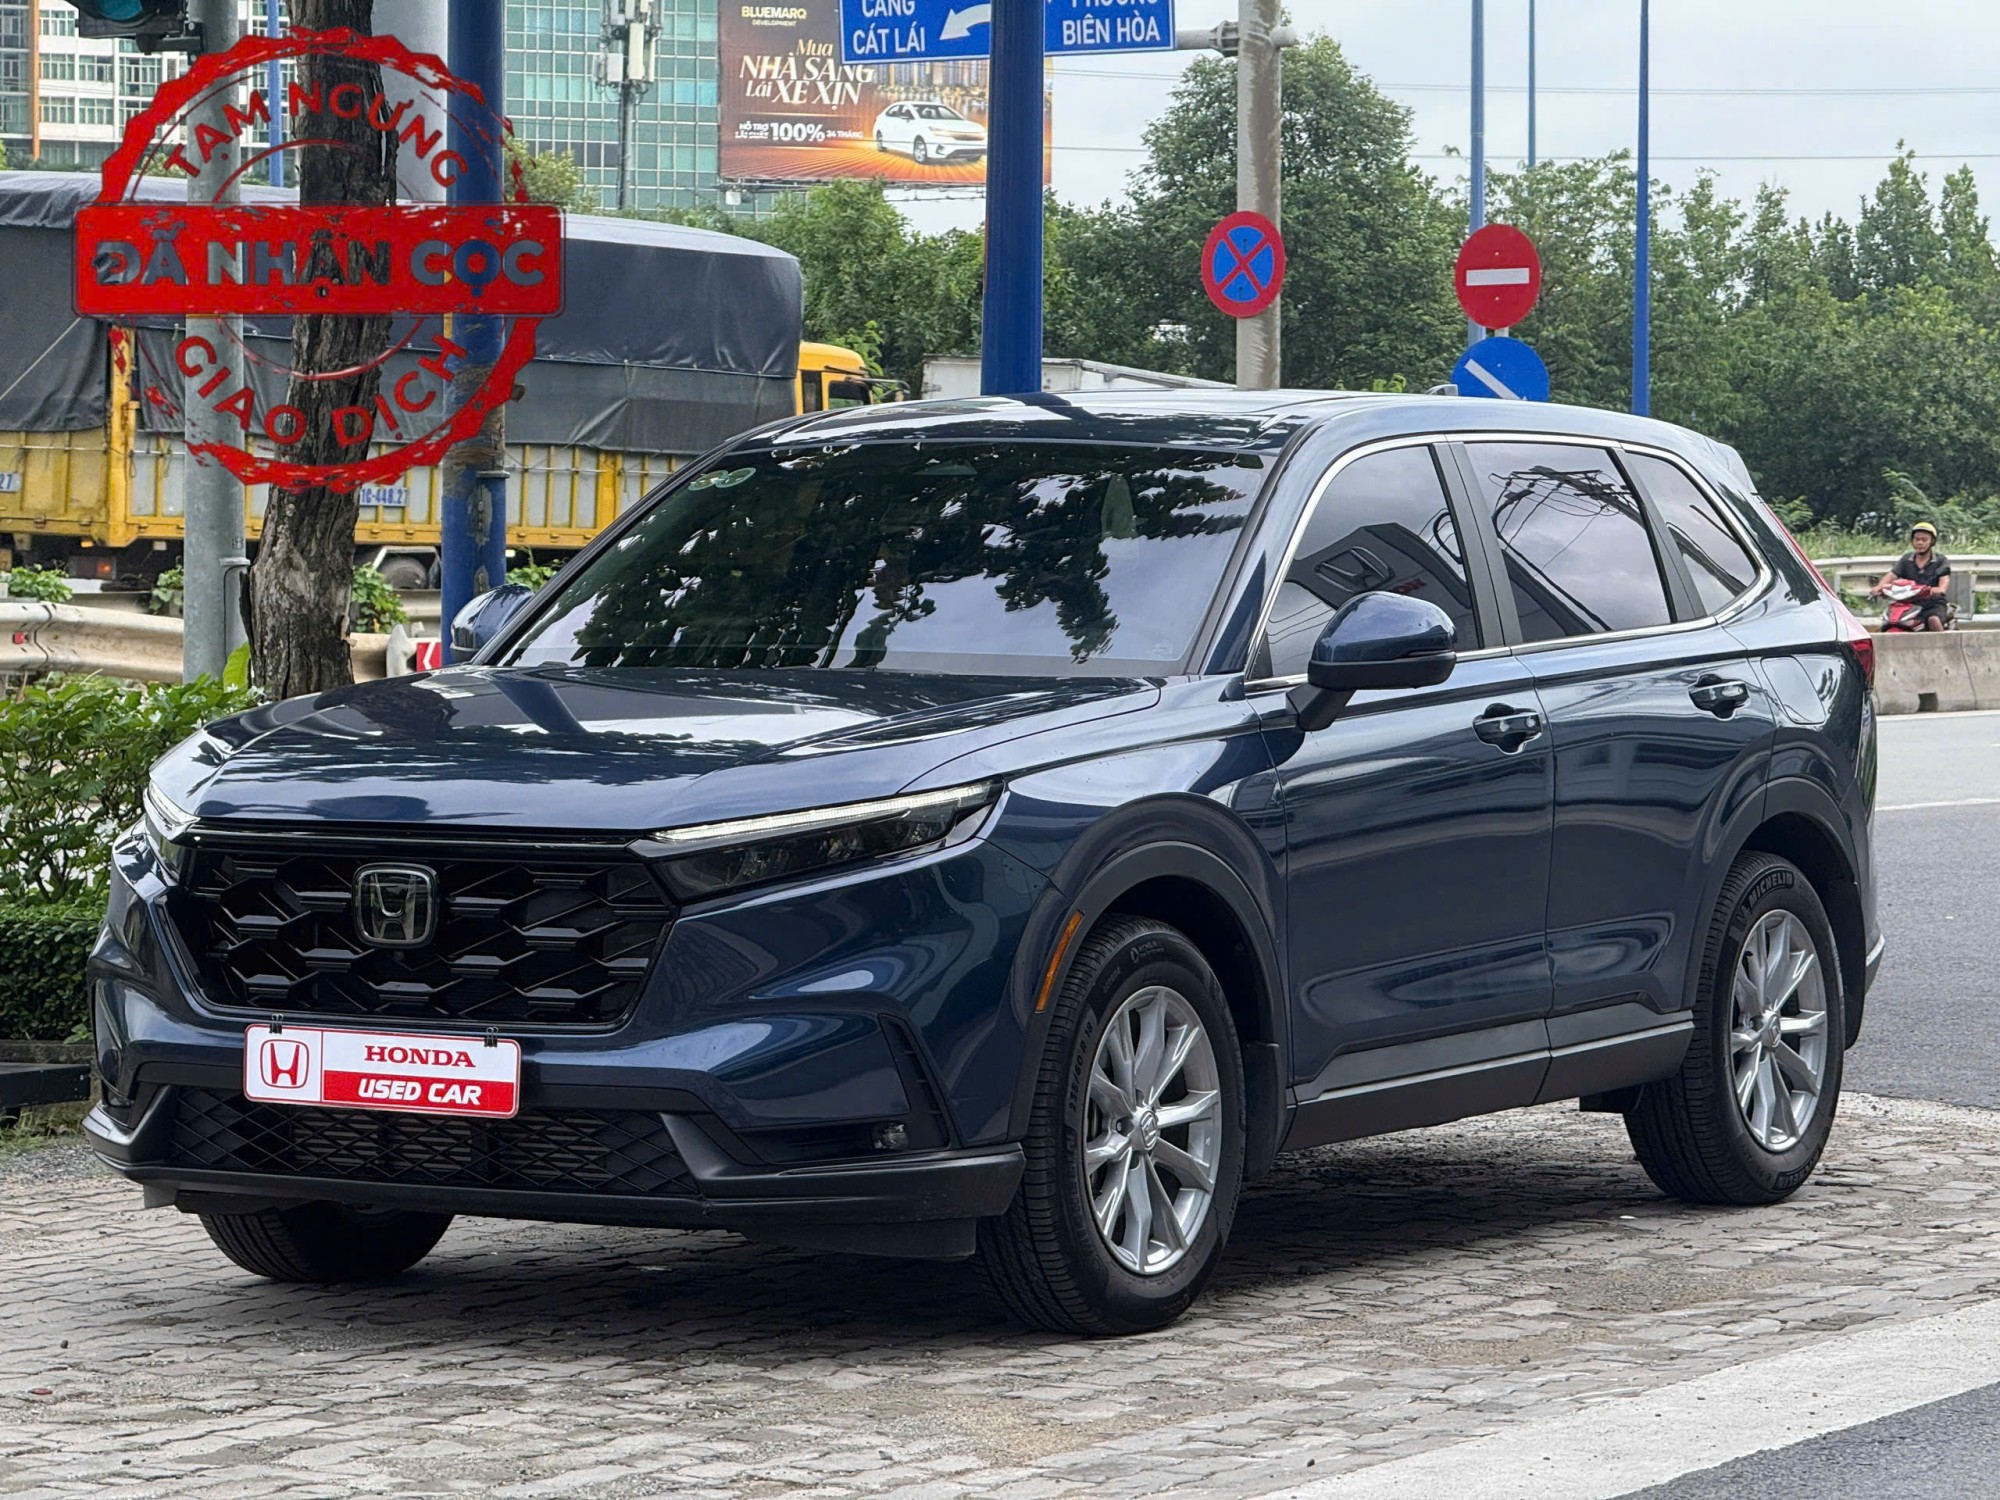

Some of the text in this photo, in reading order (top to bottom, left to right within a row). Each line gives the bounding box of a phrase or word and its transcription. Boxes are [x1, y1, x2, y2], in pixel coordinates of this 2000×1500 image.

[741, 6, 807, 19] BLUEMARQ
[853, 21, 926, 54] CÁT LÁI
[1062, 10, 1161, 45] BIÊN HÒA
[796, 39, 834, 56] Mua
[739, 52, 875, 83] NHÀ SANG
[745, 80, 862, 110] Lái XE XỊN
[770, 122, 825, 142] 100%
[1748, 871, 1794, 908] MICHELIN
[1084, 1021, 1093, 1038] 18
[364, 1045, 476, 1068] HONDA
[357, 1078, 482, 1105] USED CAR
